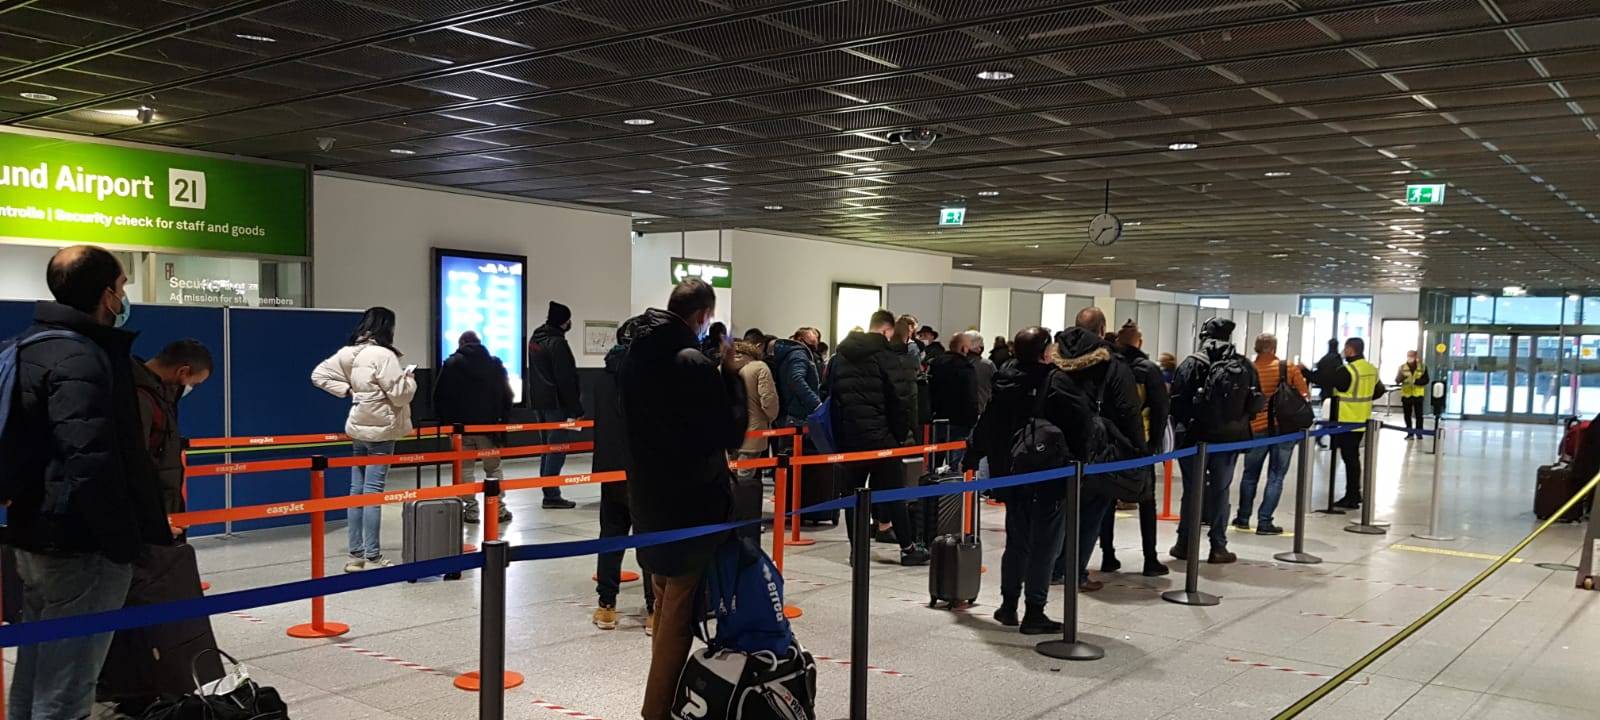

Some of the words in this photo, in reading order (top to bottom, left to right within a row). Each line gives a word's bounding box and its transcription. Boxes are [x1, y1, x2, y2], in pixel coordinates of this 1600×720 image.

[55, 165, 154, 201] Airport
[174, 178, 197, 203] 21
[54, 208, 112, 227] Security
[114, 214, 153, 228] check
[156, 217, 173, 229] for
[176, 220, 205, 232] staff
[207, 222, 229, 233] and
[232, 225, 265, 237] goods
[249, 437, 274, 445] easyJet
[215, 464, 247, 473] easyJet
[564, 474, 591, 484] easyJet
[384, 490, 417, 503] easyJet
[266, 502, 305, 515] easyJet
